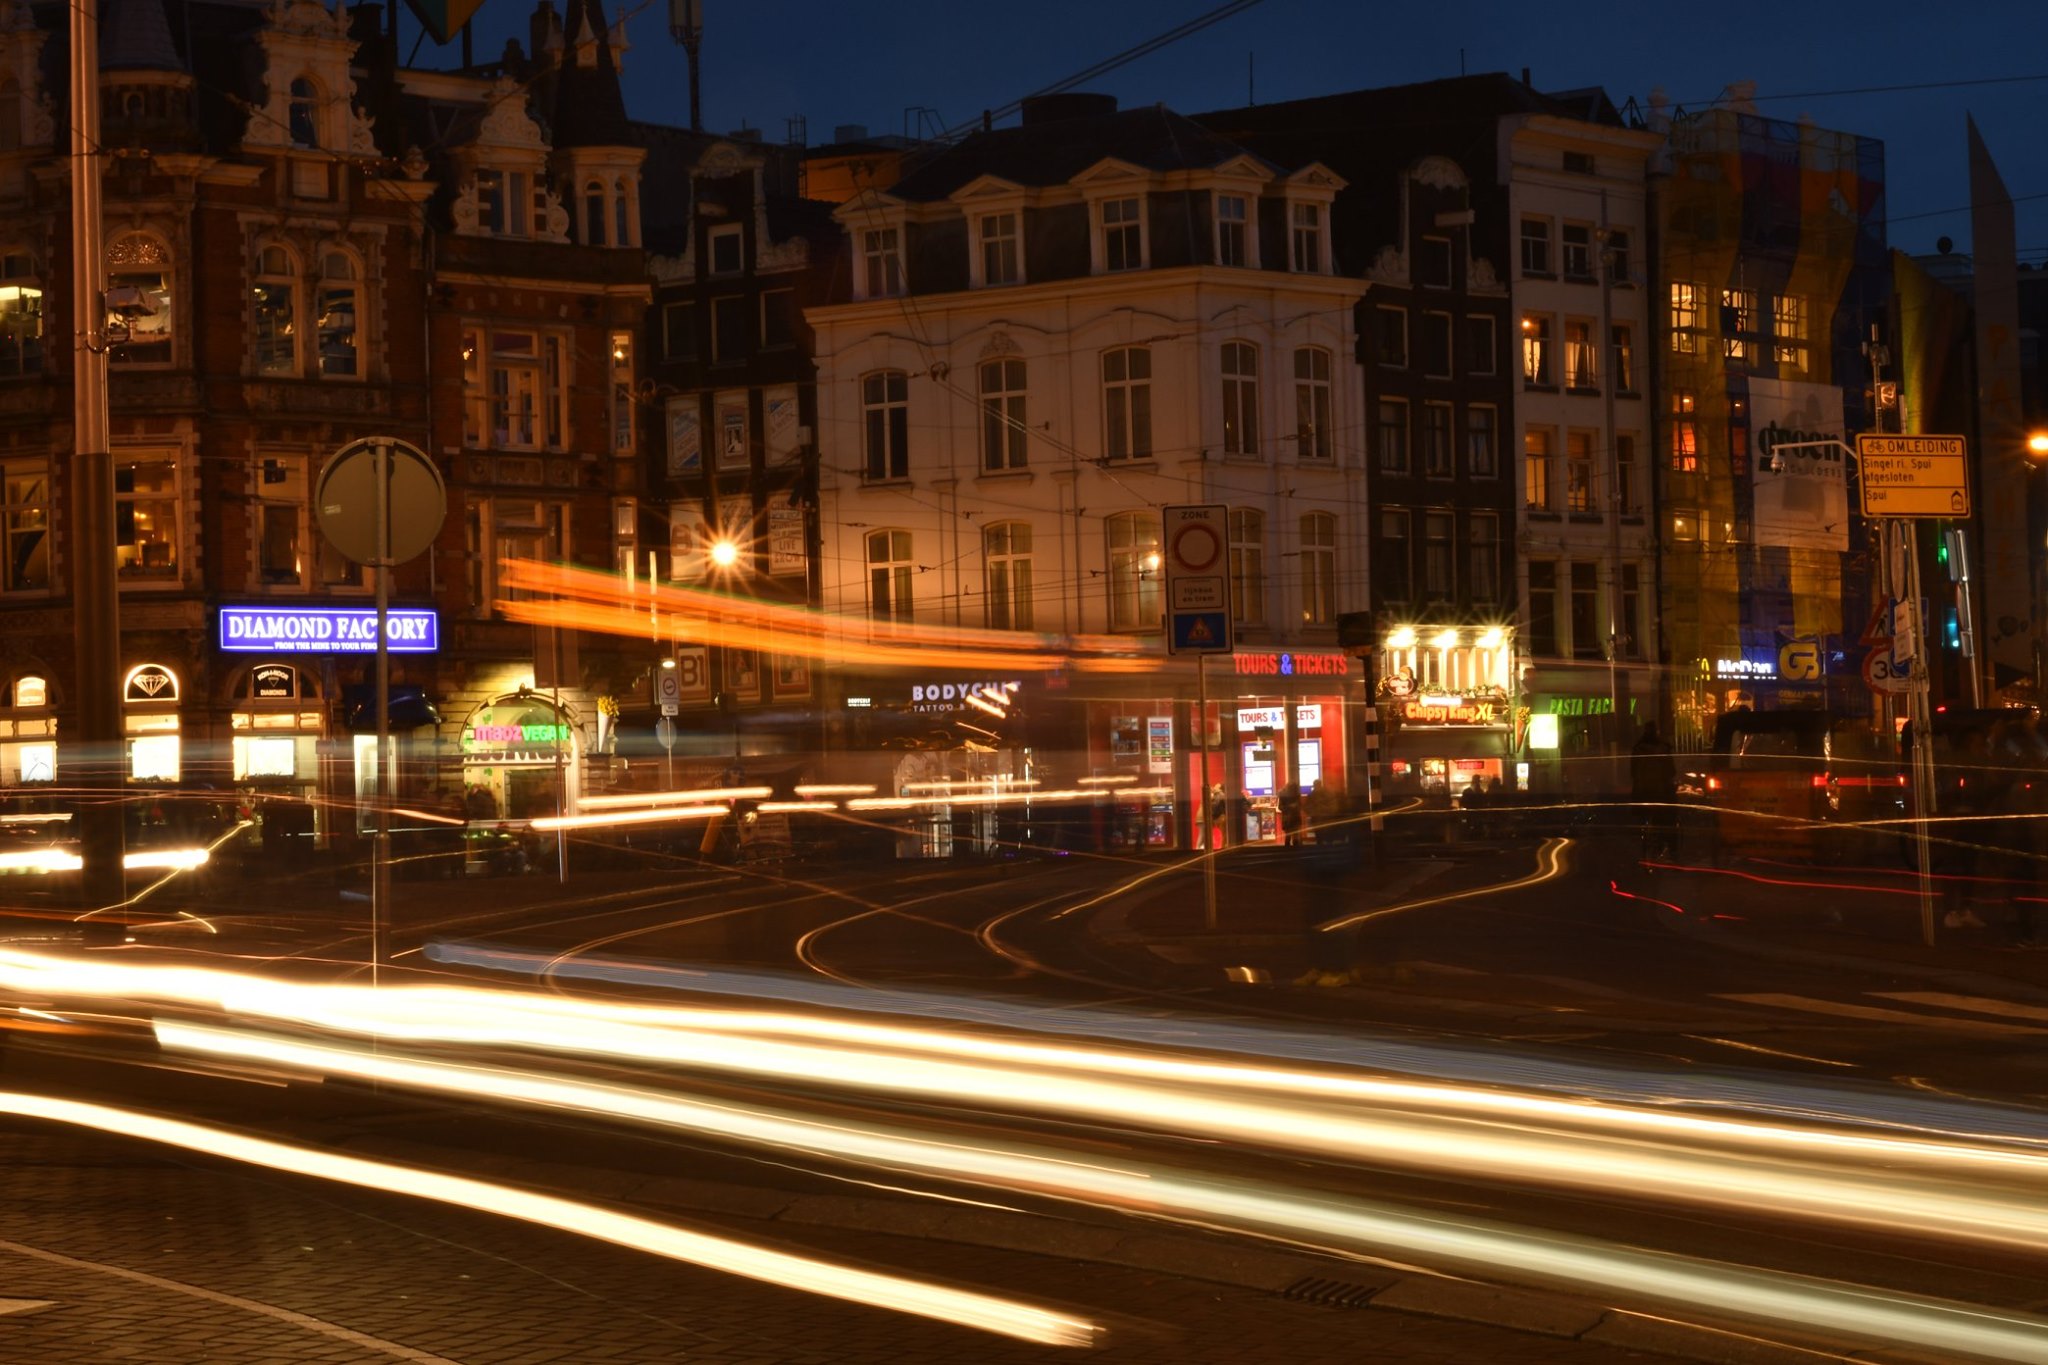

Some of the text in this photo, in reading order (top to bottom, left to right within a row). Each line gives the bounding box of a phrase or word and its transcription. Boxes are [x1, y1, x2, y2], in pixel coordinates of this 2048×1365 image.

[1887, 440, 1957, 453] OMLEIDING
[1863, 459, 1894, 471] Singel
[1911, 459, 1931, 470] Spui
[1866, 490, 1887, 501] Spui
[1181, 510, 1210, 520] ZONE
[228, 615, 429, 640] DIAMOND FACORY
[274, 641, 377, 650] FROM THE MINE TO YOUR FING
[680, 653, 705, 688] B1
[1233, 653, 1348, 675] TOURS & TICKETS
[913, 703, 953, 713] TATTOO
[1405, 702, 1448, 722] Chipsy
[1550, 698, 1637, 716] PASTA FACY
[1240, 709, 1315, 723] TOURS & TETS
